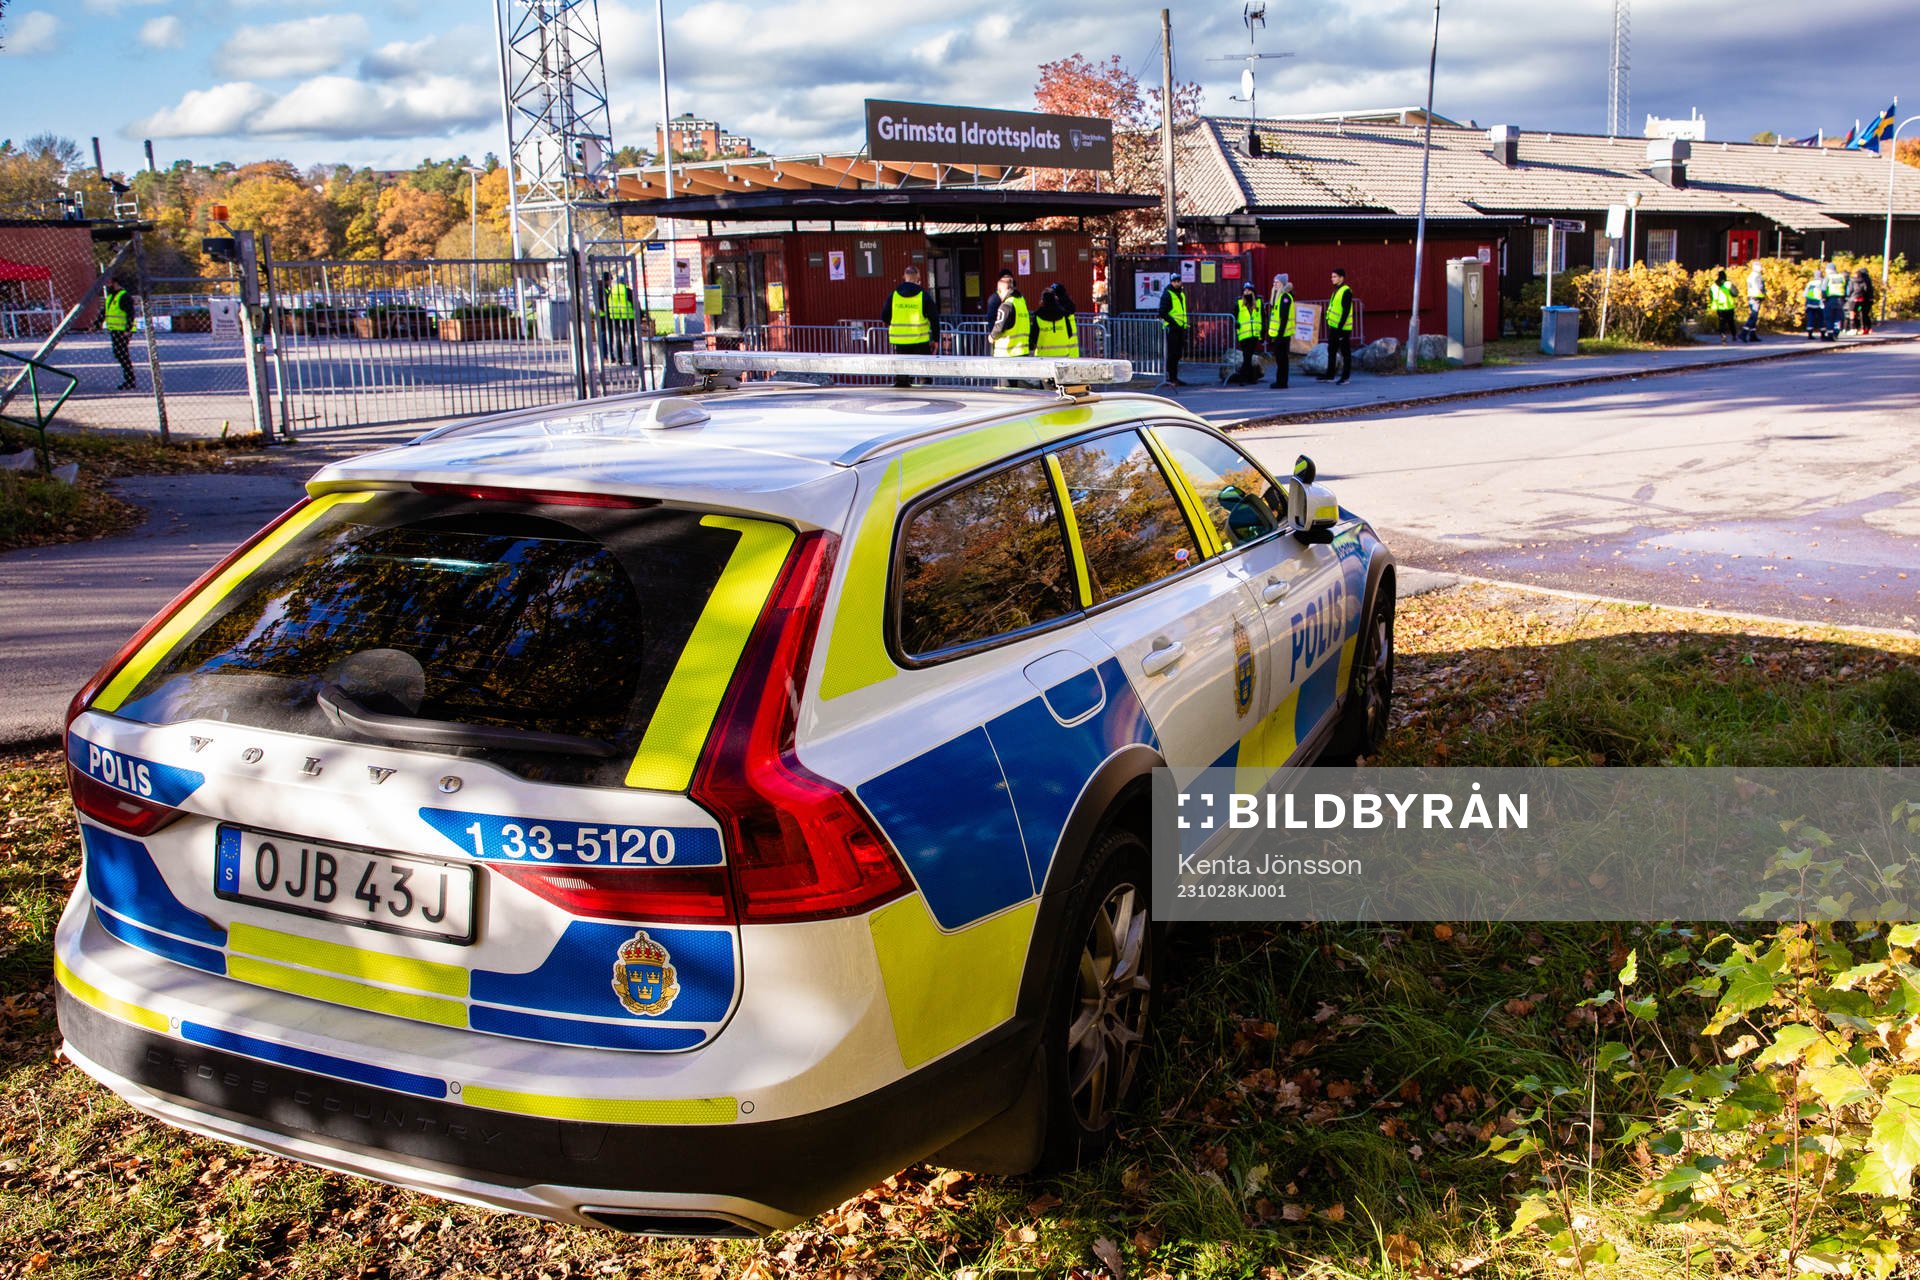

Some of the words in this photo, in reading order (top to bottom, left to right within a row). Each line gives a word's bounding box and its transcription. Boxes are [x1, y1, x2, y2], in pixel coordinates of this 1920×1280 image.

[877, 115, 957, 145] Grimsta
[961, 120, 1062, 152] Idrottsplats
[859, 241, 877, 249] Entré
[864, 251, 873, 274] 1
[1042, 249, 1049, 270] 1
[1289, 580, 1342, 684] POLIS
[88, 743, 153, 797] POLIS
[189, 735, 463, 795] VOLVO
[466, 821, 485, 856] 1
[501, 824, 676, 865] 33-5120
[225, 867, 234, 881] S
[254, 841, 338, 903] OJB
[354, 860, 448, 924] 43J
[144, 1046, 272, 1095] CROSS
[293, 1089, 502, 1145] COUNTRY
